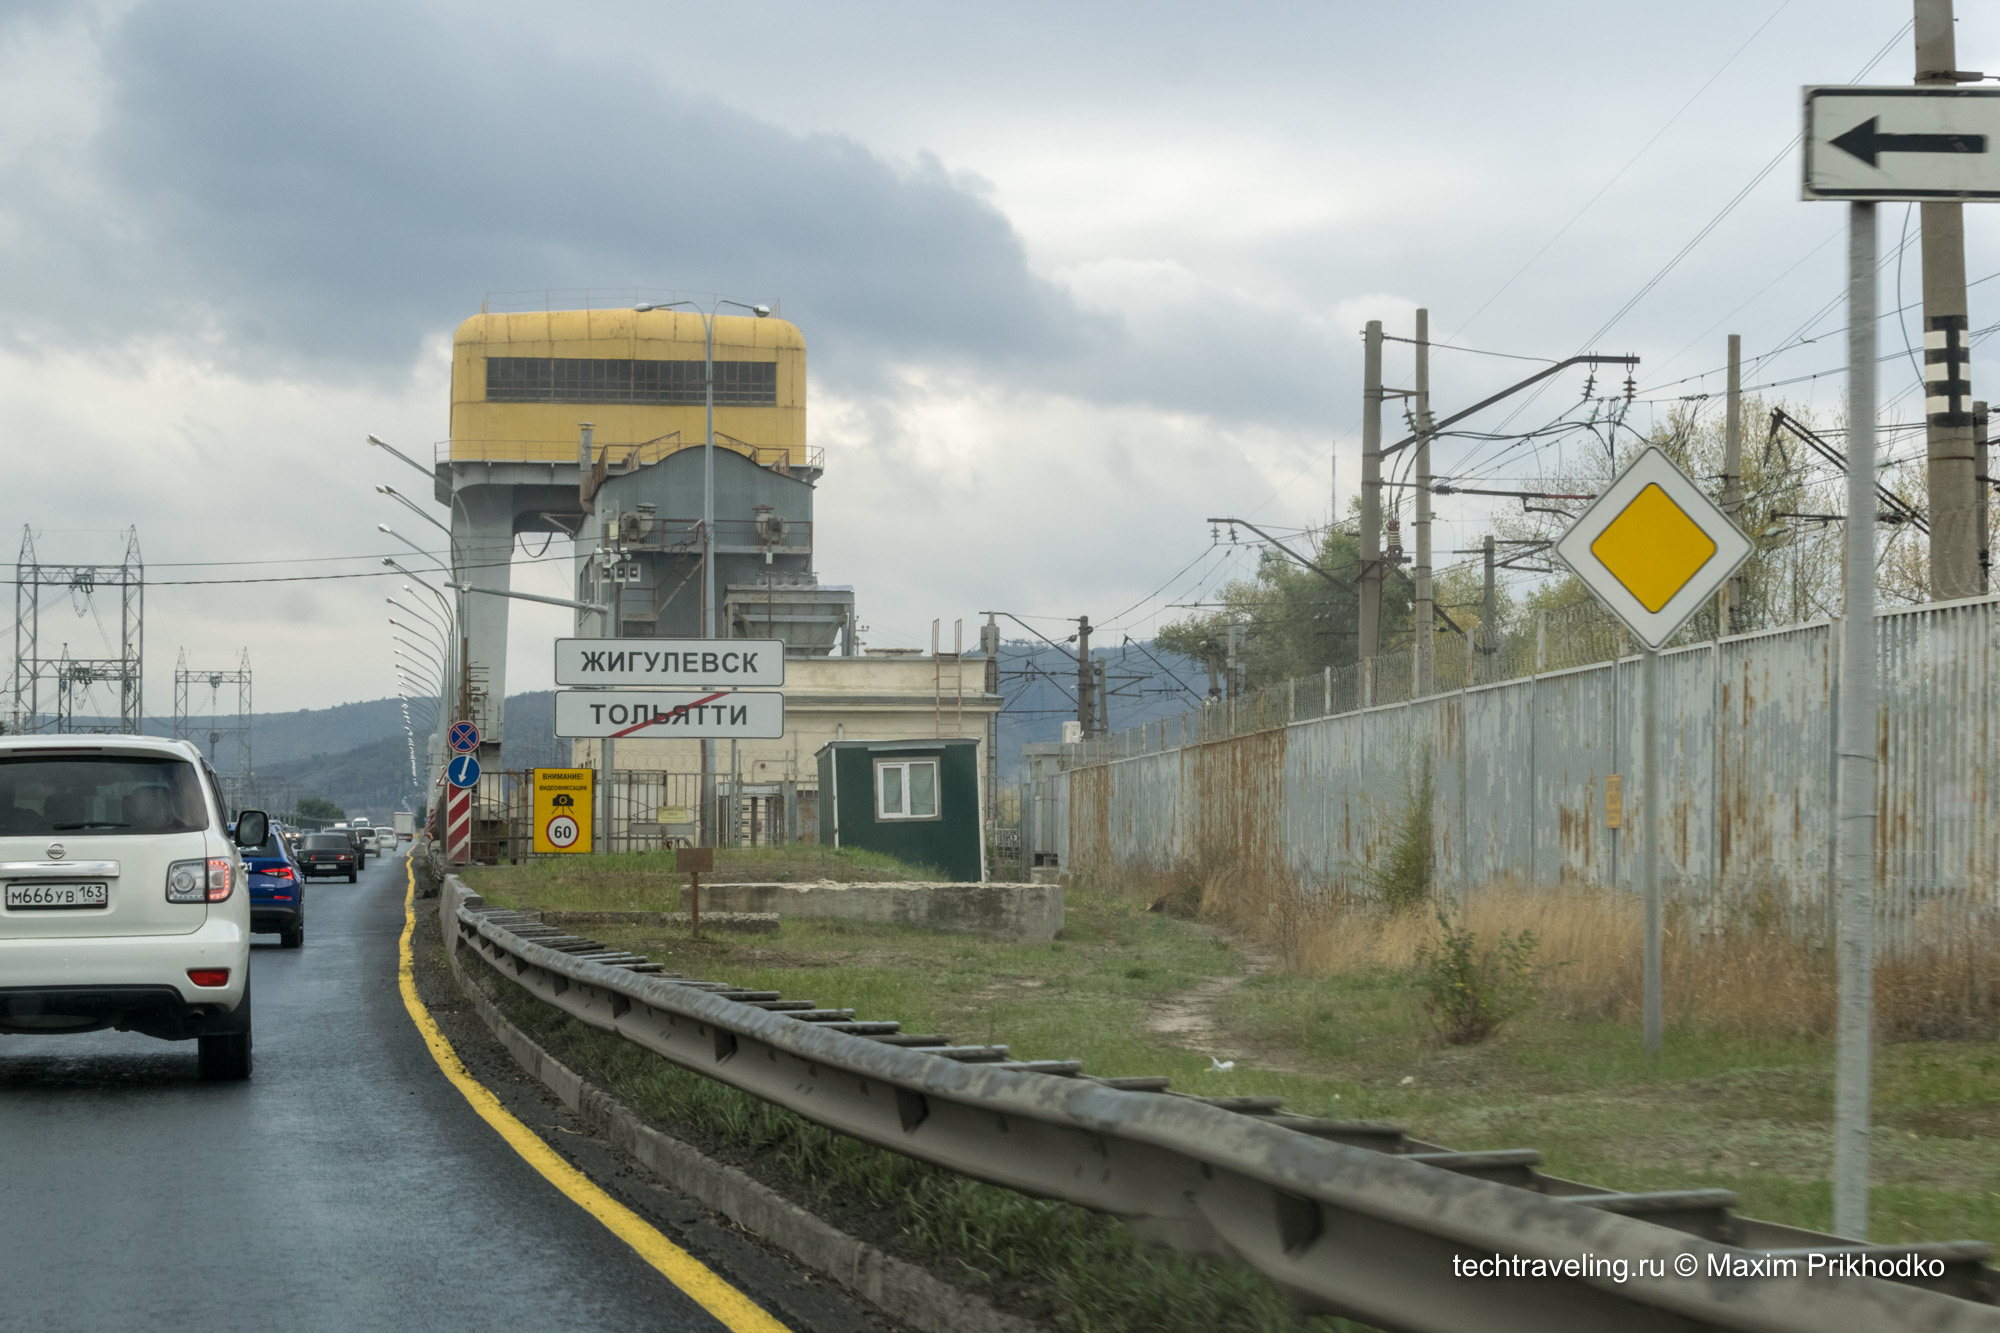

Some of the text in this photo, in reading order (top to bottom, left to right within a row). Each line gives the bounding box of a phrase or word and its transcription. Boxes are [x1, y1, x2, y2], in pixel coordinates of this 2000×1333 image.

[581, 651, 759, 674] ЖИГУЛЕВСК
[590, 704, 748, 725] ТОЛЬЯТТИ
[554, 825, 572, 839] 60
[79, 885, 103, 898] 163
